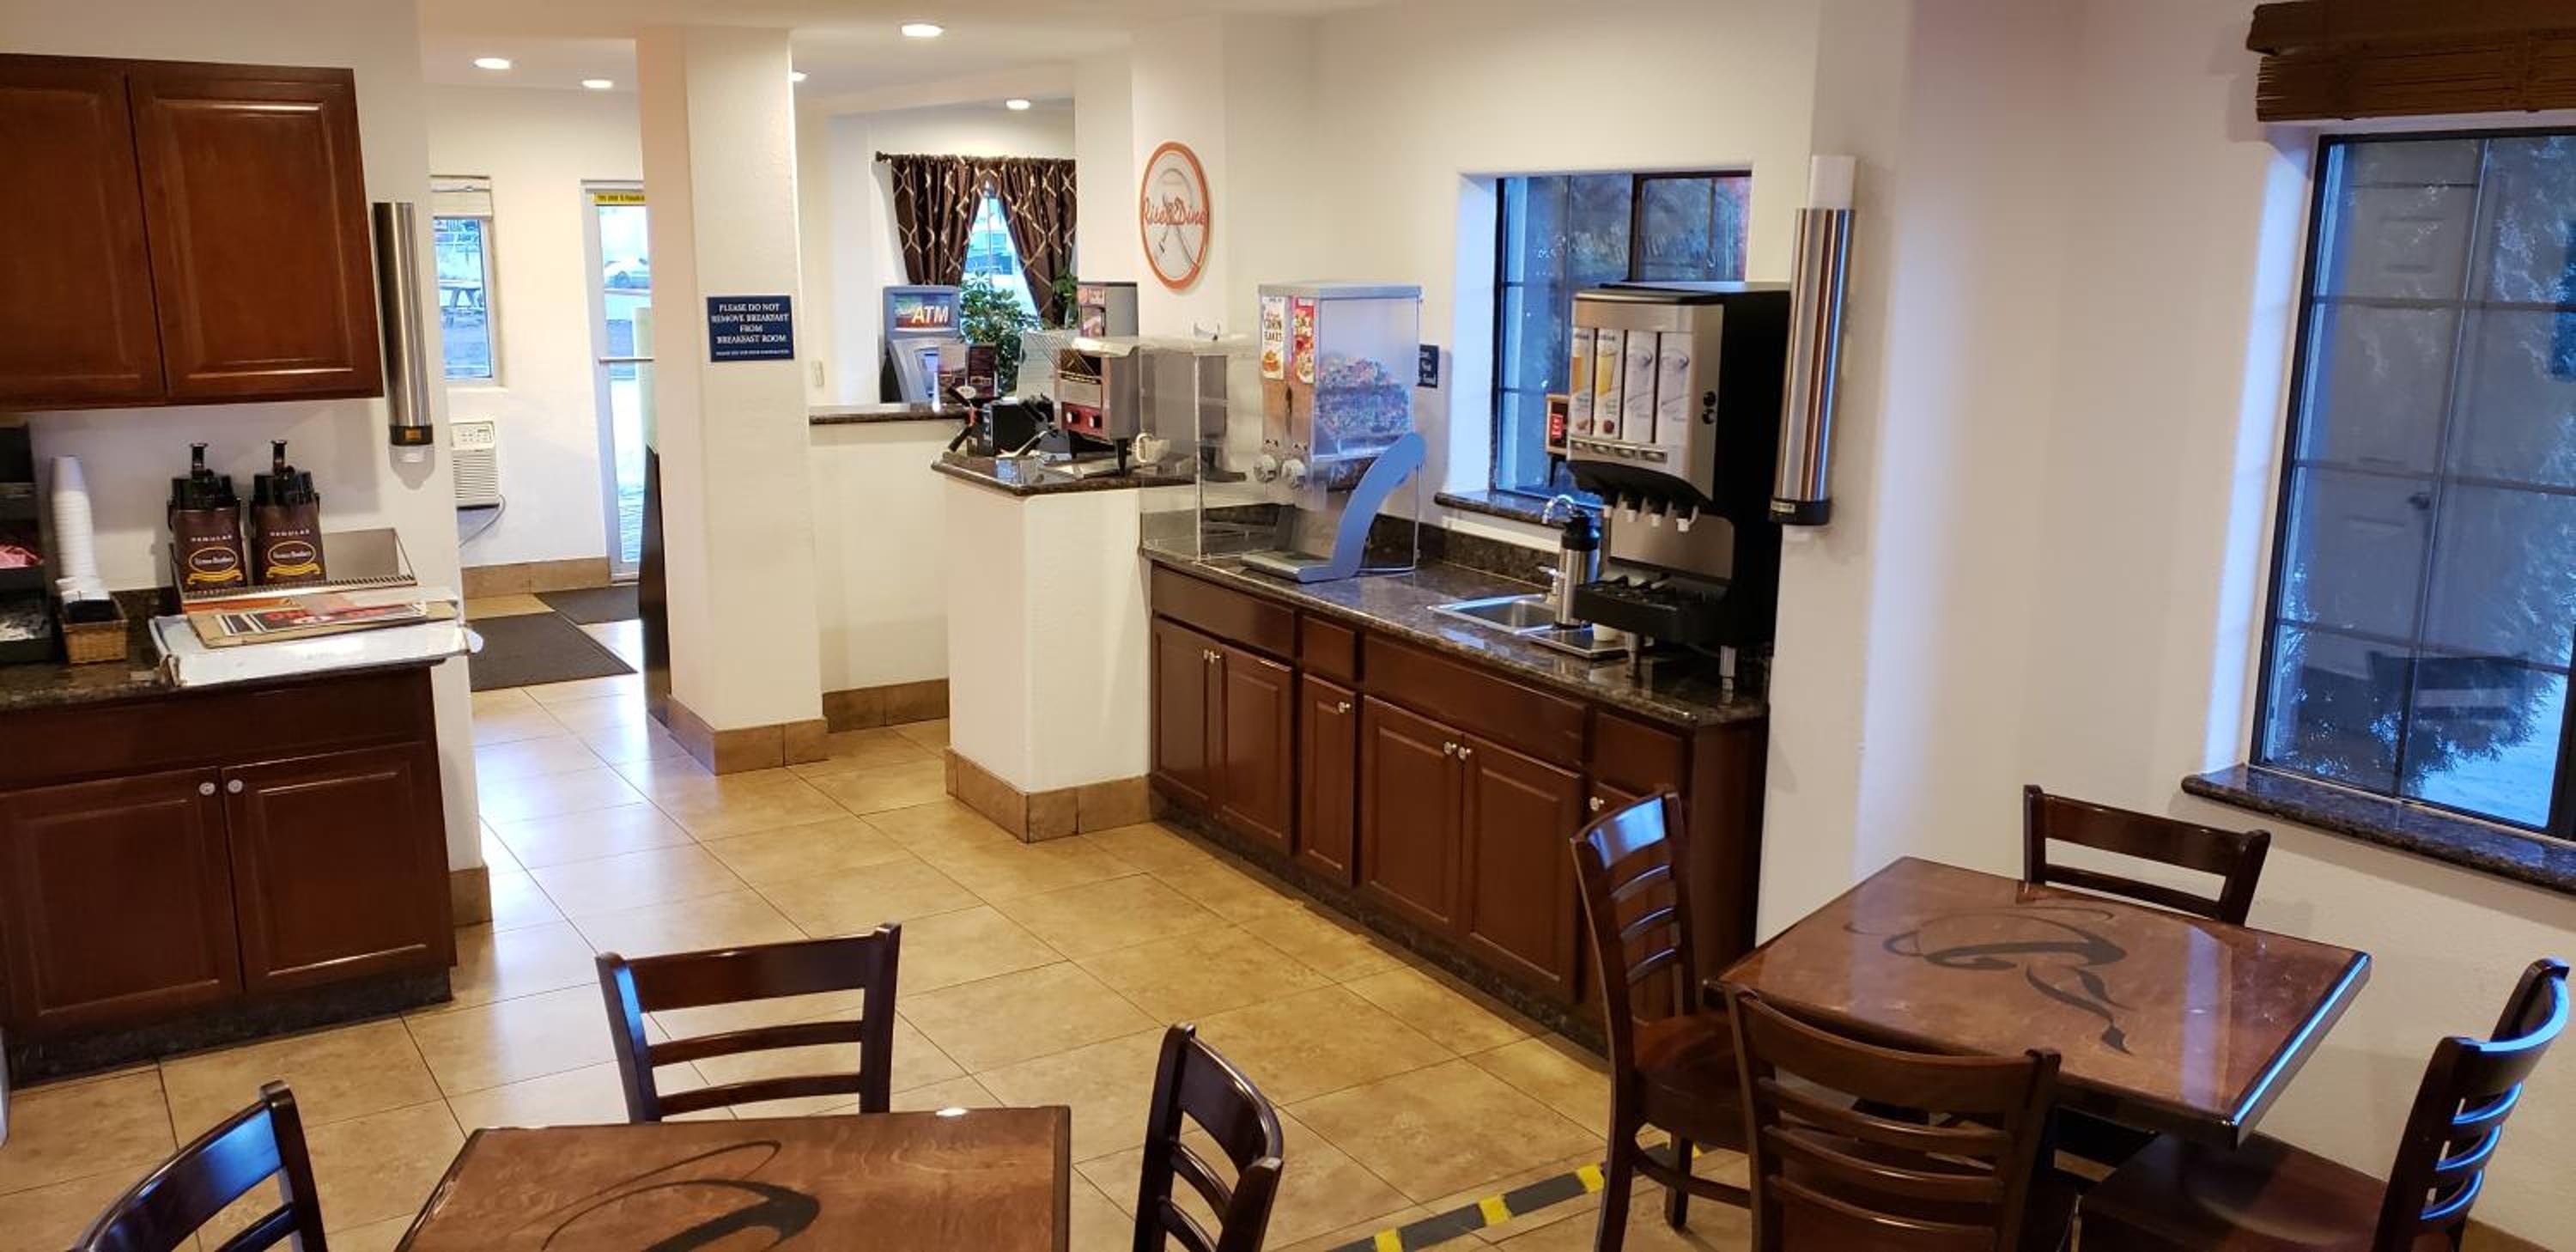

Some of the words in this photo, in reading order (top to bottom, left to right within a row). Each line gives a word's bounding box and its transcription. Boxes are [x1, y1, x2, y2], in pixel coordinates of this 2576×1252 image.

[719, 303, 747, 313] PLEASE
[748, 303, 762, 312] DO
[762, 303, 781, 312] NOT
[711, 314, 745, 323] REMOVE
[746, 313, 789, 322] BREAKFAST
[911, 304, 950, 324] ATM
[716, 335, 760, 344] BREAKFAST
[762, 334, 787, 343] ROOM
